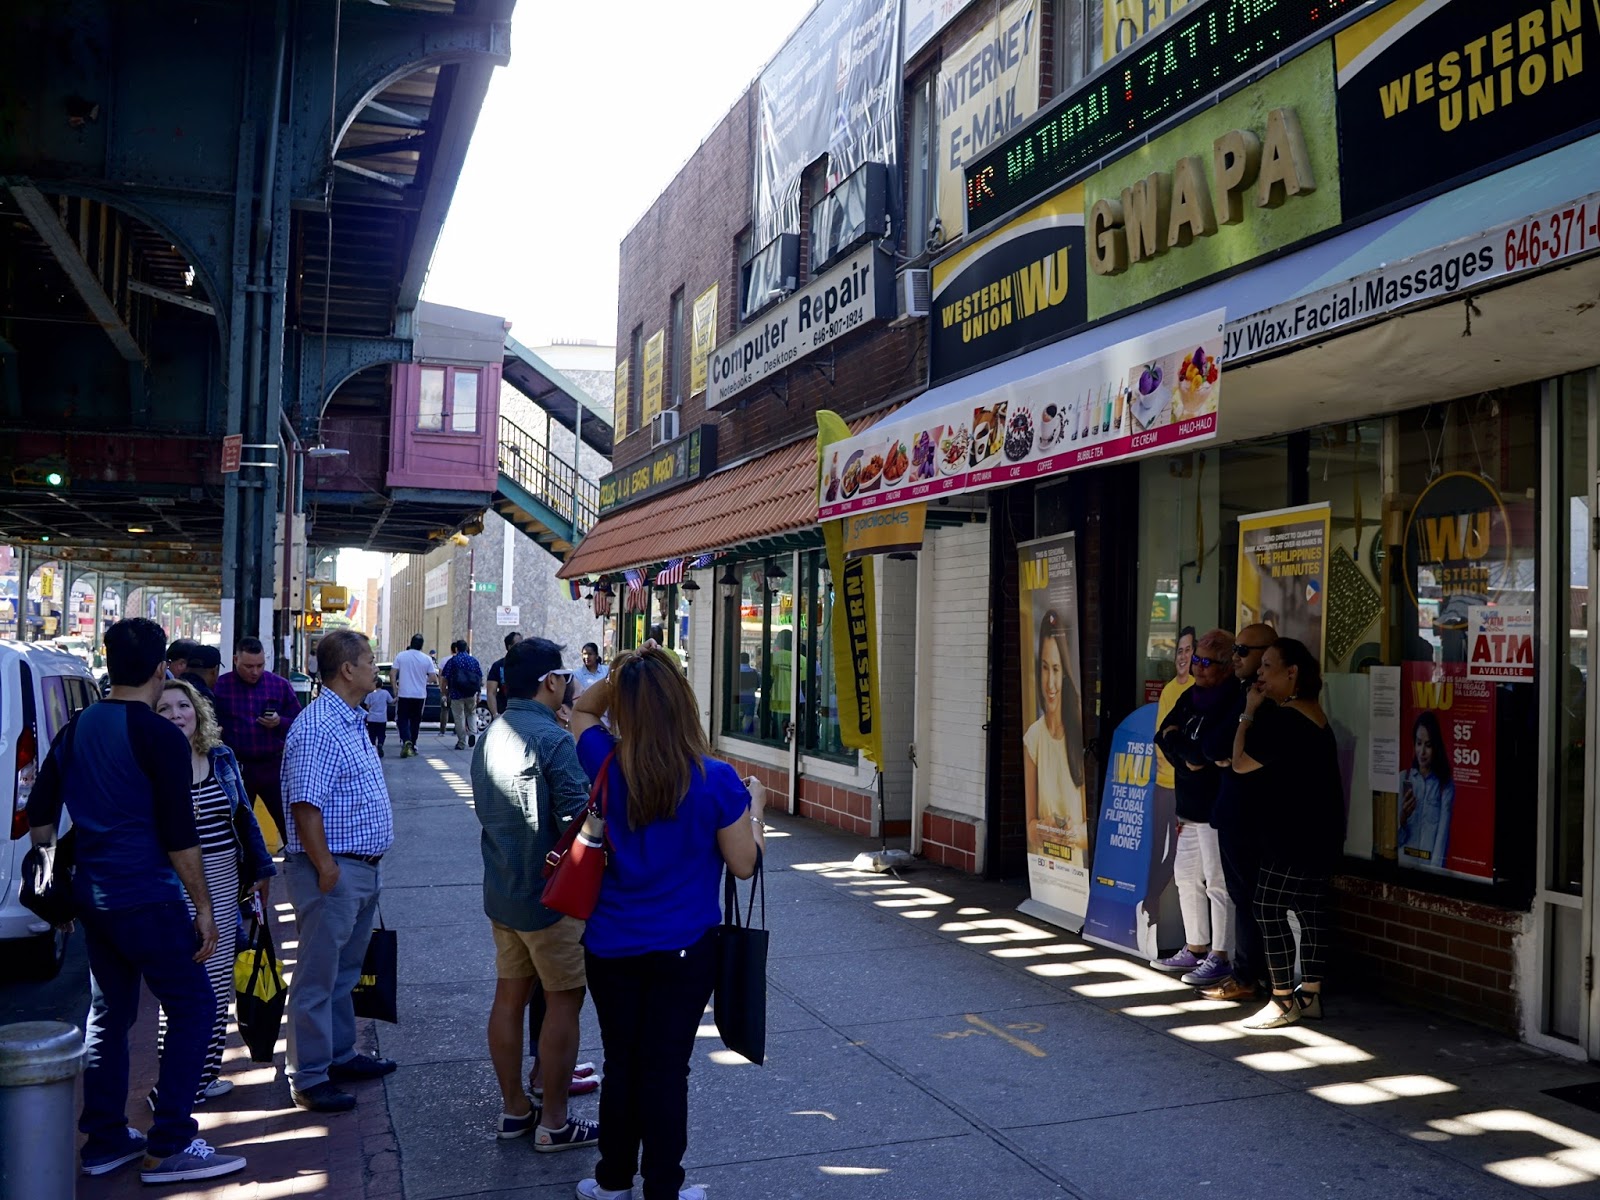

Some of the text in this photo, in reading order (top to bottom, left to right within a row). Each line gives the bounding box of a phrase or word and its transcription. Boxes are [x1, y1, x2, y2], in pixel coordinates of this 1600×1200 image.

[1380, 0, 1582, 119] WESTERN
[1439, 33, 1583, 132] UNION
[950, 86, 1023, 172] E-MAIL
[1089, 107, 1315, 277] GWAPA
[1503, 200, 1600, 273] 646-371-
[942, 276, 1012, 329] WESTERN
[713, 317, 790, 385] Computer
[798, 261, 871, 334] Repair
[962, 301, 1012, 344] UNION
[719, 373, 753, 400] Notebooks
[763, 347, 799, 374] Desktops
[1179, 416, 1213, 436] HALO-HALO
[1131, 432, 1158, 448] ICE CREAM
[1077, 446, 1104, 461] BUBBLE TEA
[1037, 459, 1053, 472] COFFEE
[1424, 511, 1491, 561] WU
[1256, 546, 1322, 566] THE PHILIPPINES
[1024, 558, 1049, 590] WU
[1272, 562, 1320, 578] IN MINUTES
[1427, 567, 1490, 581] ESTERN
[846, 574, 871, 721] WESTERN
[1472, 634, 1533, 664] ATM
[1478, 667, 1524, 676] AVAILABLE
[1416, 681, 1454, 711] WU
[1462, 683, 1486, 691] REGALO
[1463, 690, 1490, 698] LLEGADO
[1127, 741, 1154, 756] THIS IS
[1453, 747, 1480, 766] $50
[1117, 752, 1153, 787] WU
[1112, 785, 1147, 801] THE WAY
[1113, 797, 1145, 814] GLOBAL
[1105, 808, 1143, 826] FILIPINOS
[1117, 823, 1142, 839] MOVE
[1109, 834, 1141, 851] MONEY
